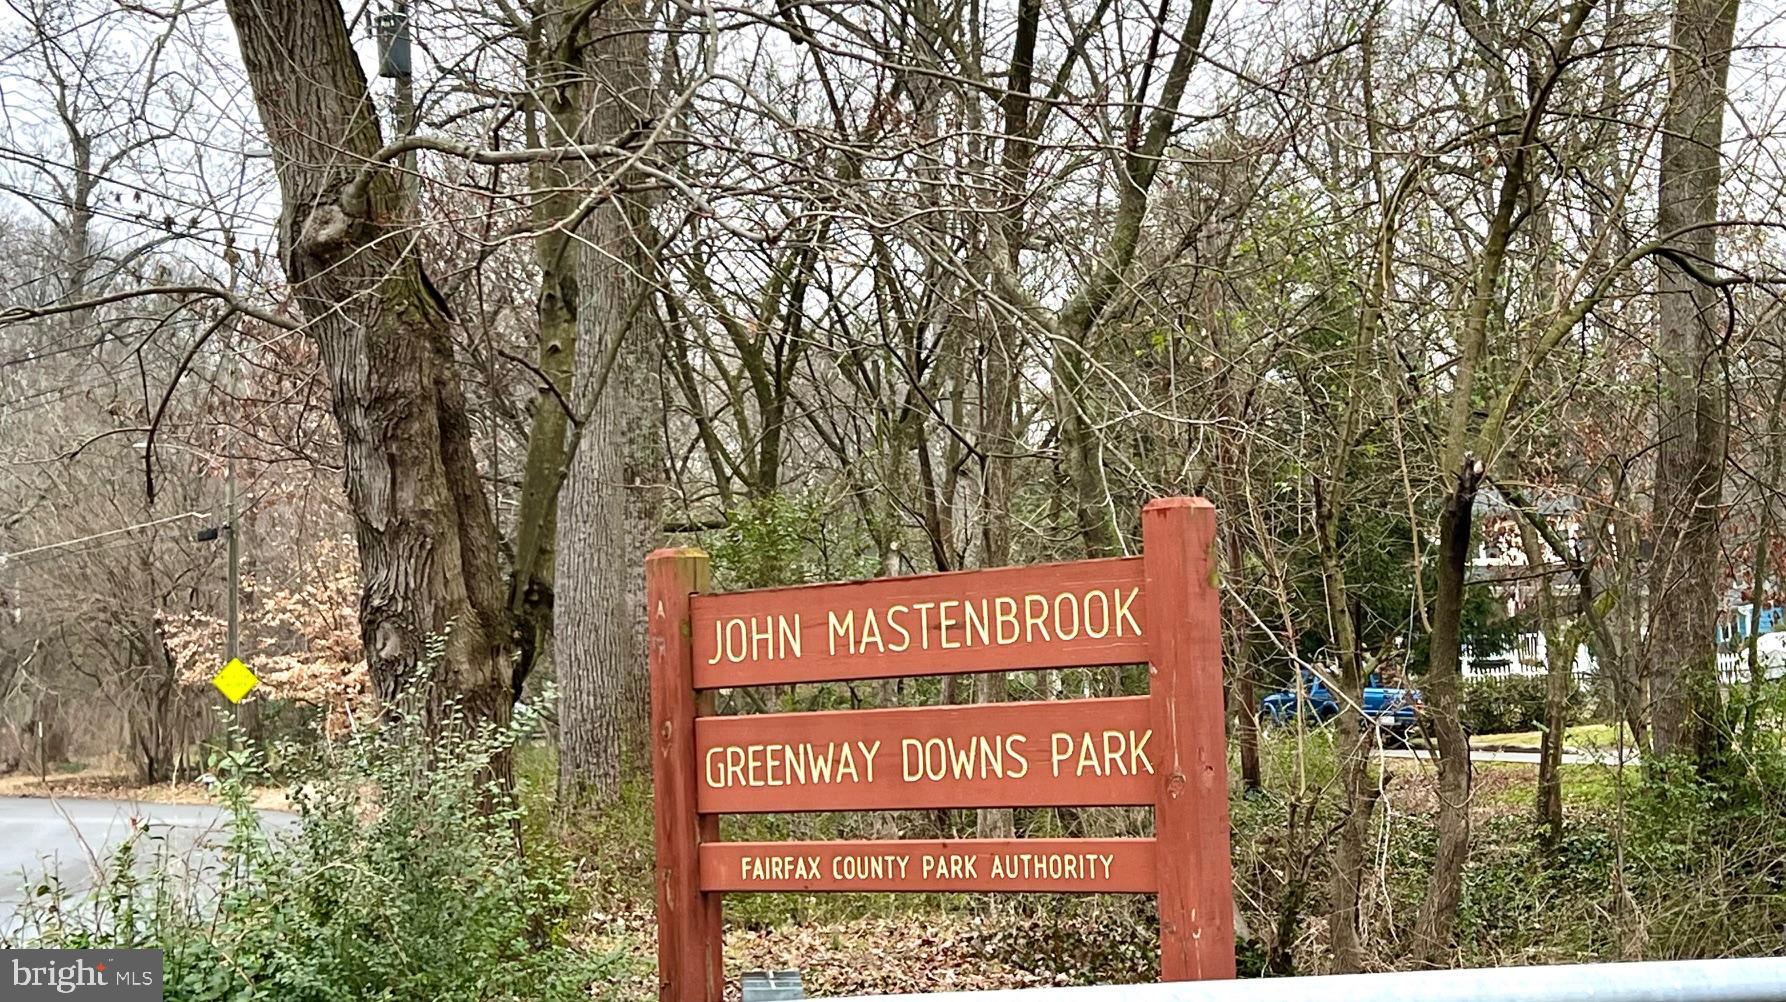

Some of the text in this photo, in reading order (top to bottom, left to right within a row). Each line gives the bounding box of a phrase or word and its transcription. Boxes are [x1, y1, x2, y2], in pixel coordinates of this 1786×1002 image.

[707, 587, 1143, 666] JOHN MASTENBROOK
[706, 730, 1156, 788] GREENWAY DOWNS PARK
[741, 854, 1114, 881] FAIRFAX COUNTY PARK AUTHORITY
